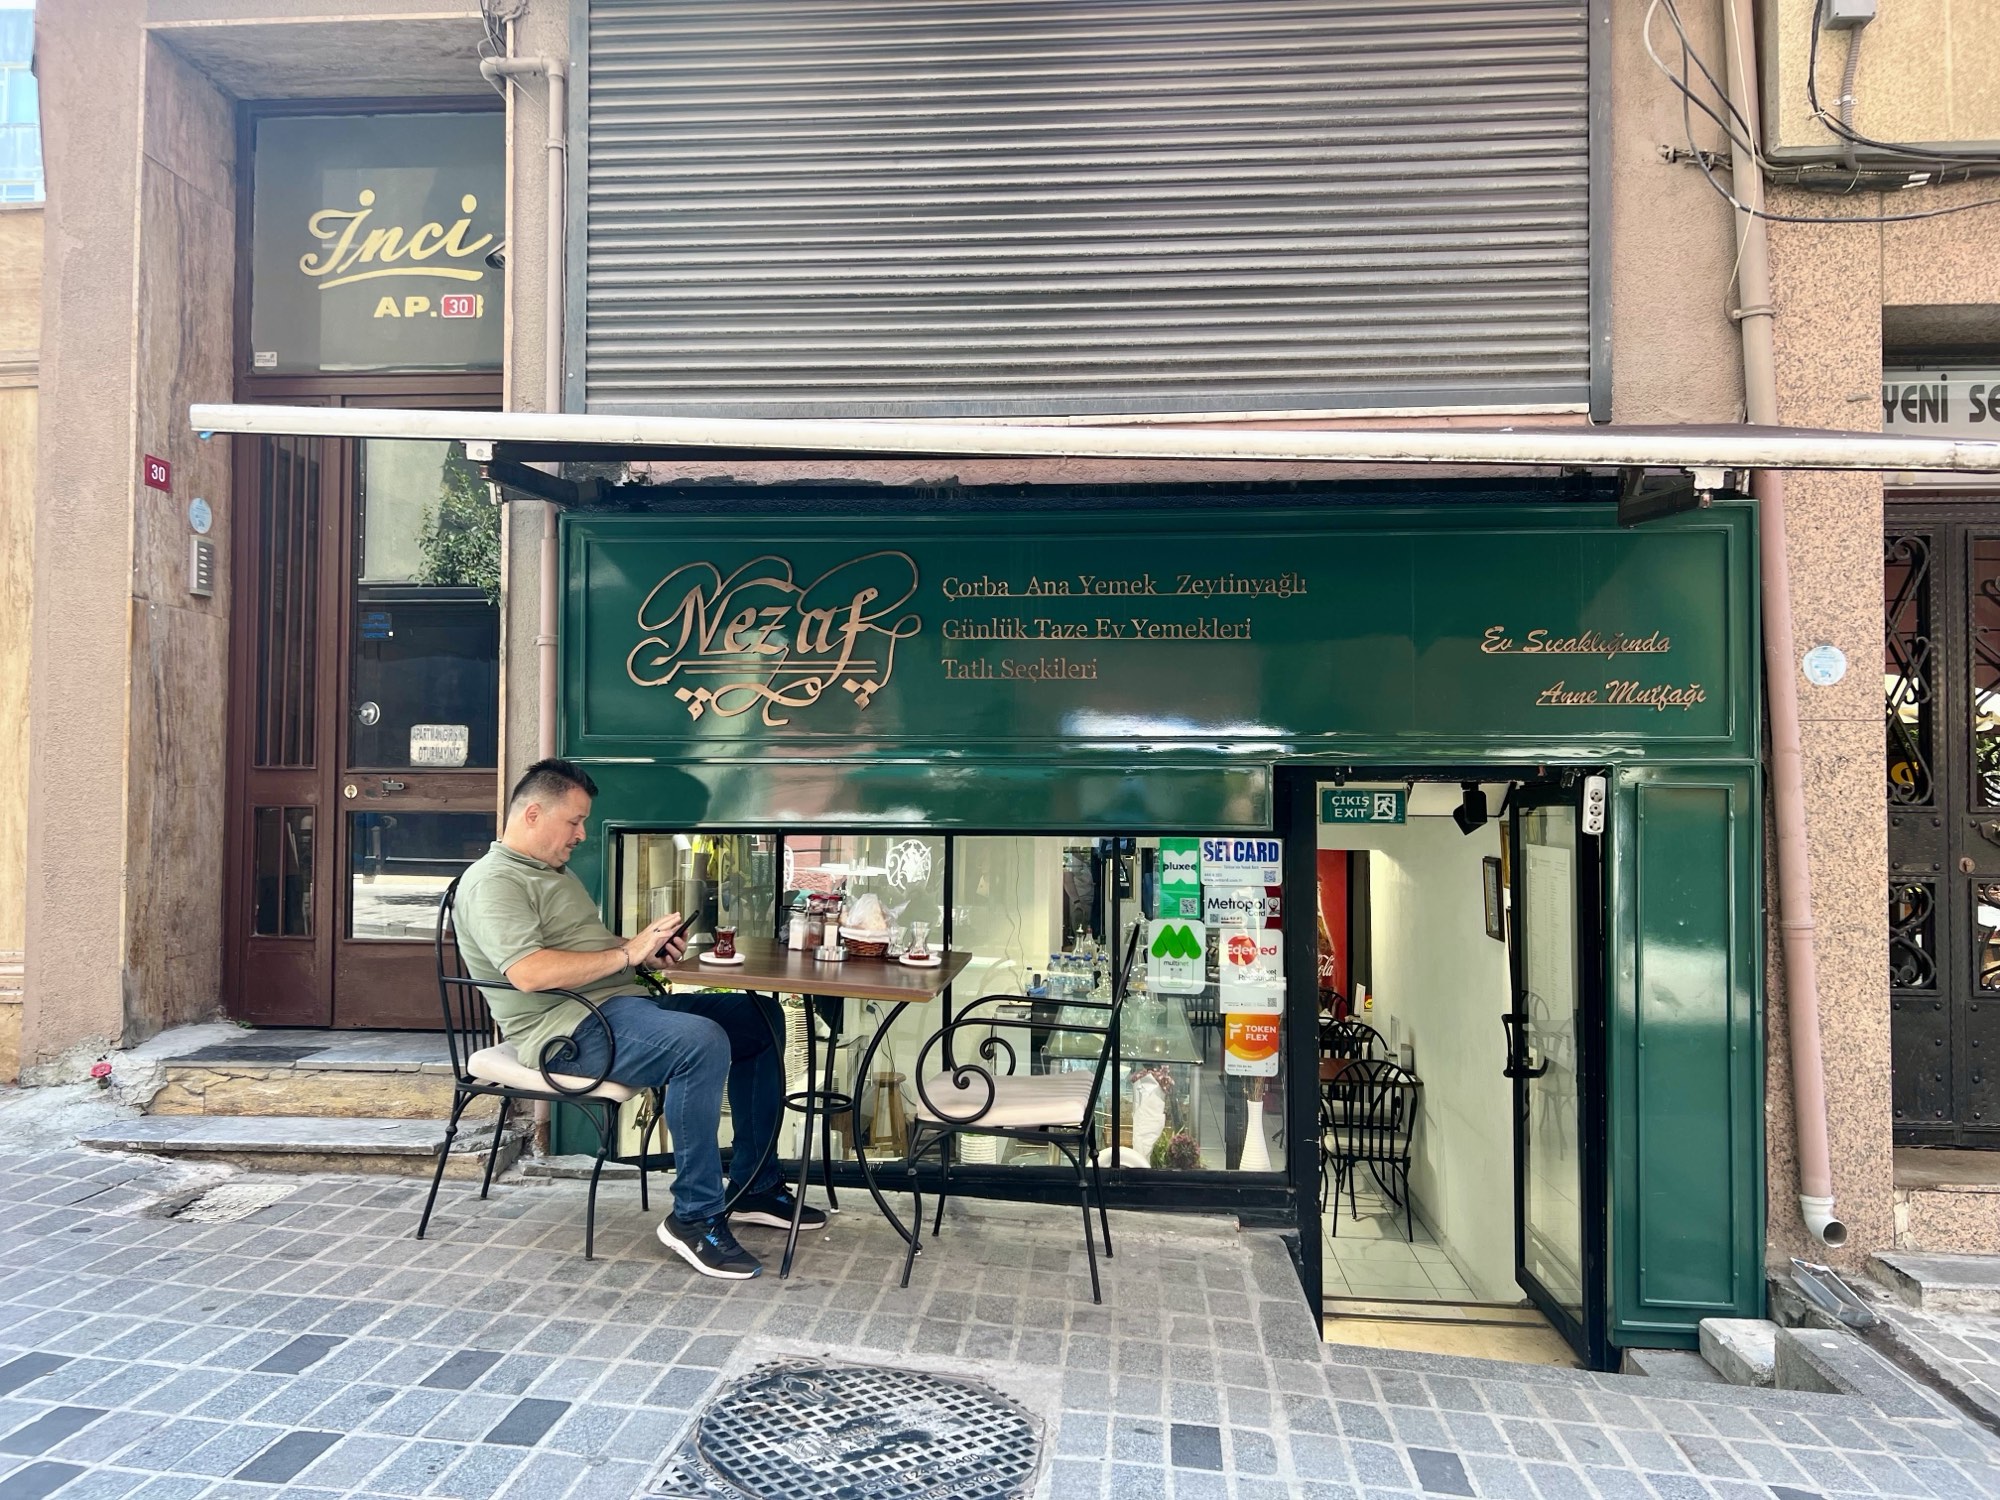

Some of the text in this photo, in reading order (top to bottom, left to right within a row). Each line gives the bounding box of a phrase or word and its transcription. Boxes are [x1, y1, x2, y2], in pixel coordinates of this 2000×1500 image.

[373, 296, 438, 318] AP.
[449, 299, 469, 314] 30
[1882, 374, 1949, 424] YENİ
[151, 463, 166, 483] 30
[942, 572, 1308, 601] Çorba Ana Yemek Zeytinyağlı
[942, 617, 1252, 640] Günlük Taze Ev Yemekleri
[1480, 626, 1514, 652] Ev
[942, 657, 1098, 684] Tatlı Seçkileri
[1536, 680, 1707, 711] Anne Mutfağı
[1331, 796, 1370, 807] ÇIKIŞ
[1334, 808, 1367, 818] EXIT
[1203, 841, 1280, 862] SETCARD
[1162, 862, 1198, 873] pluxee
[1207, 897, 1266, 912] Metropol
[1227, 944, 1278, 956] Edened
[1245, 1024, 1277, 1034] TOKEN
[1245, 1033, 1269, 1042] FLEX
